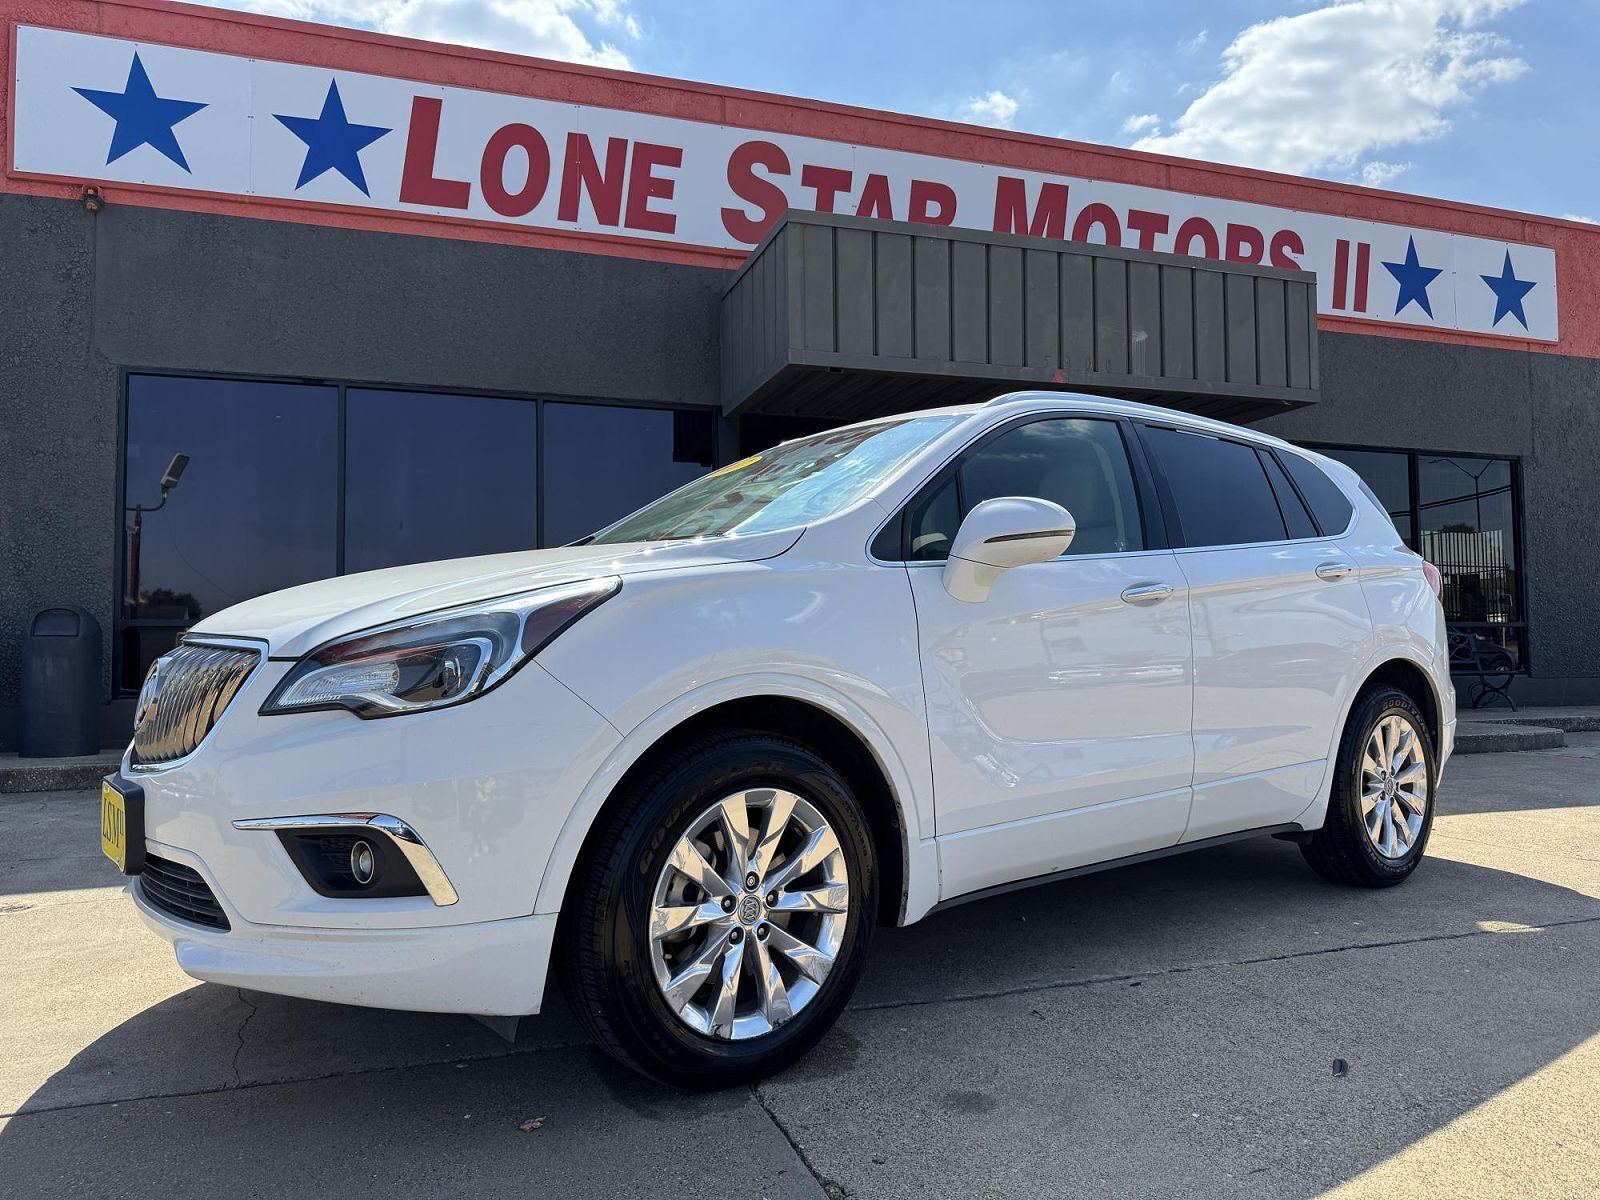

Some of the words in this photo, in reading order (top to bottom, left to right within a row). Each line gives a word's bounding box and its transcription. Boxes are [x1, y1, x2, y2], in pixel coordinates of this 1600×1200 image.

[400, 95, 684, 235] LONE
[720, 140, 957, 245] STAR
[993, 175, 1306, 272] MOTORS
[1332, 238, 1371, 313] II
